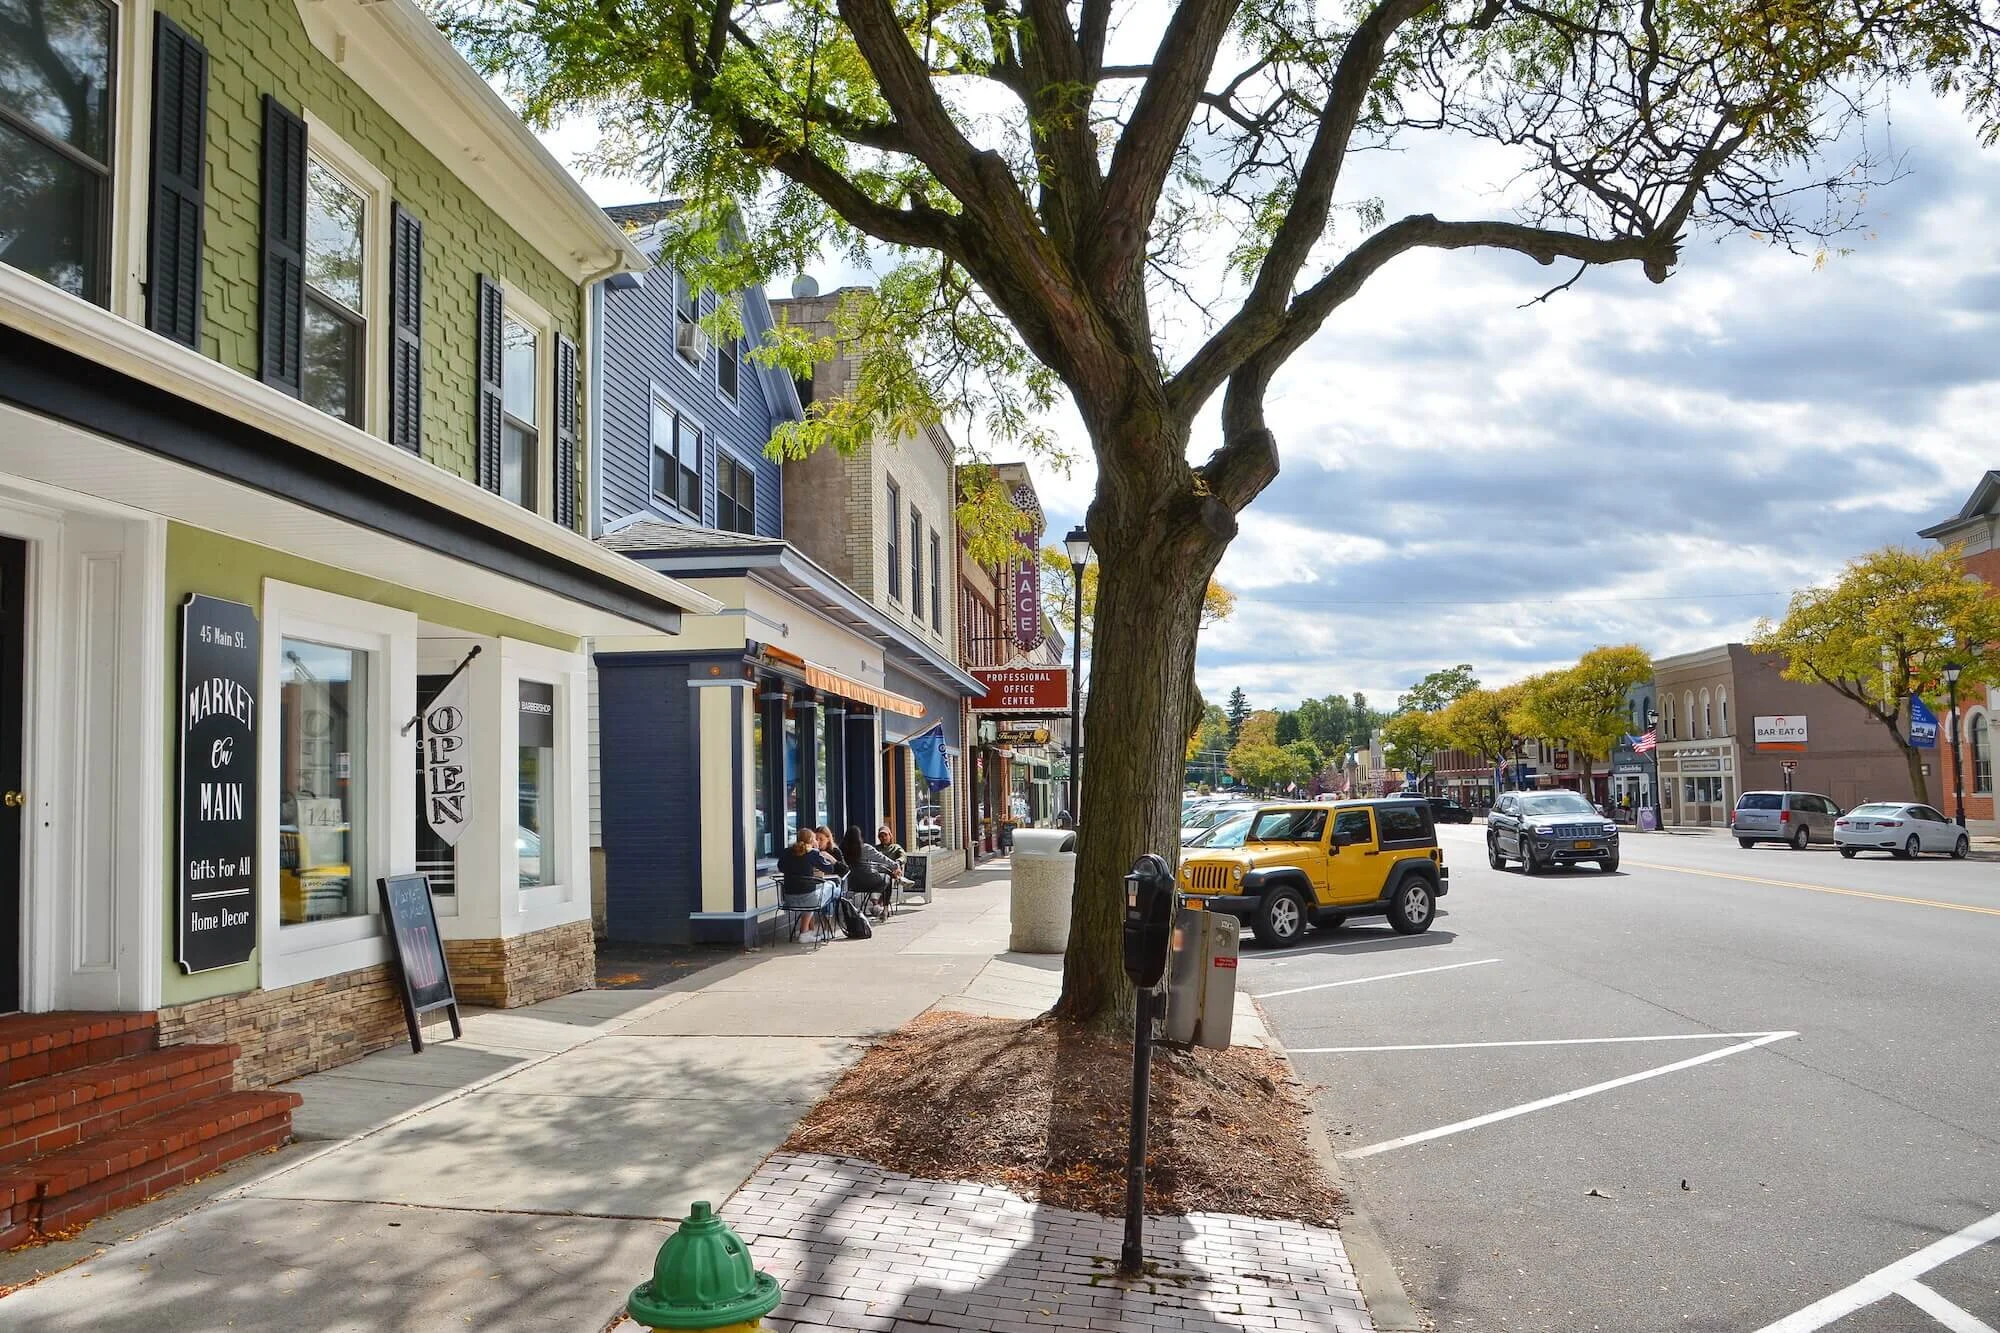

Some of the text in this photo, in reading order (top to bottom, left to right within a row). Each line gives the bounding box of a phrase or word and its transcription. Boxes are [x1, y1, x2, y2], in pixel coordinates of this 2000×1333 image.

[200, 625, 247, 649] 45 Main St.
[986, 672, 1051, 682] PROFESSIONAL
[1003, 684, 1035, 694] OFFICE
[189, 677, 255, 732] MARKET
[1001, 696, 1035, 705] CENTER
[211, 737, 234, 769] On
[427, 705, 465, 824] OPEN
[200, 782, 243, 822] MAIN
[190, 856, 251, 881] Gifts For All
[191, 907, 250, 932] Home Decor
